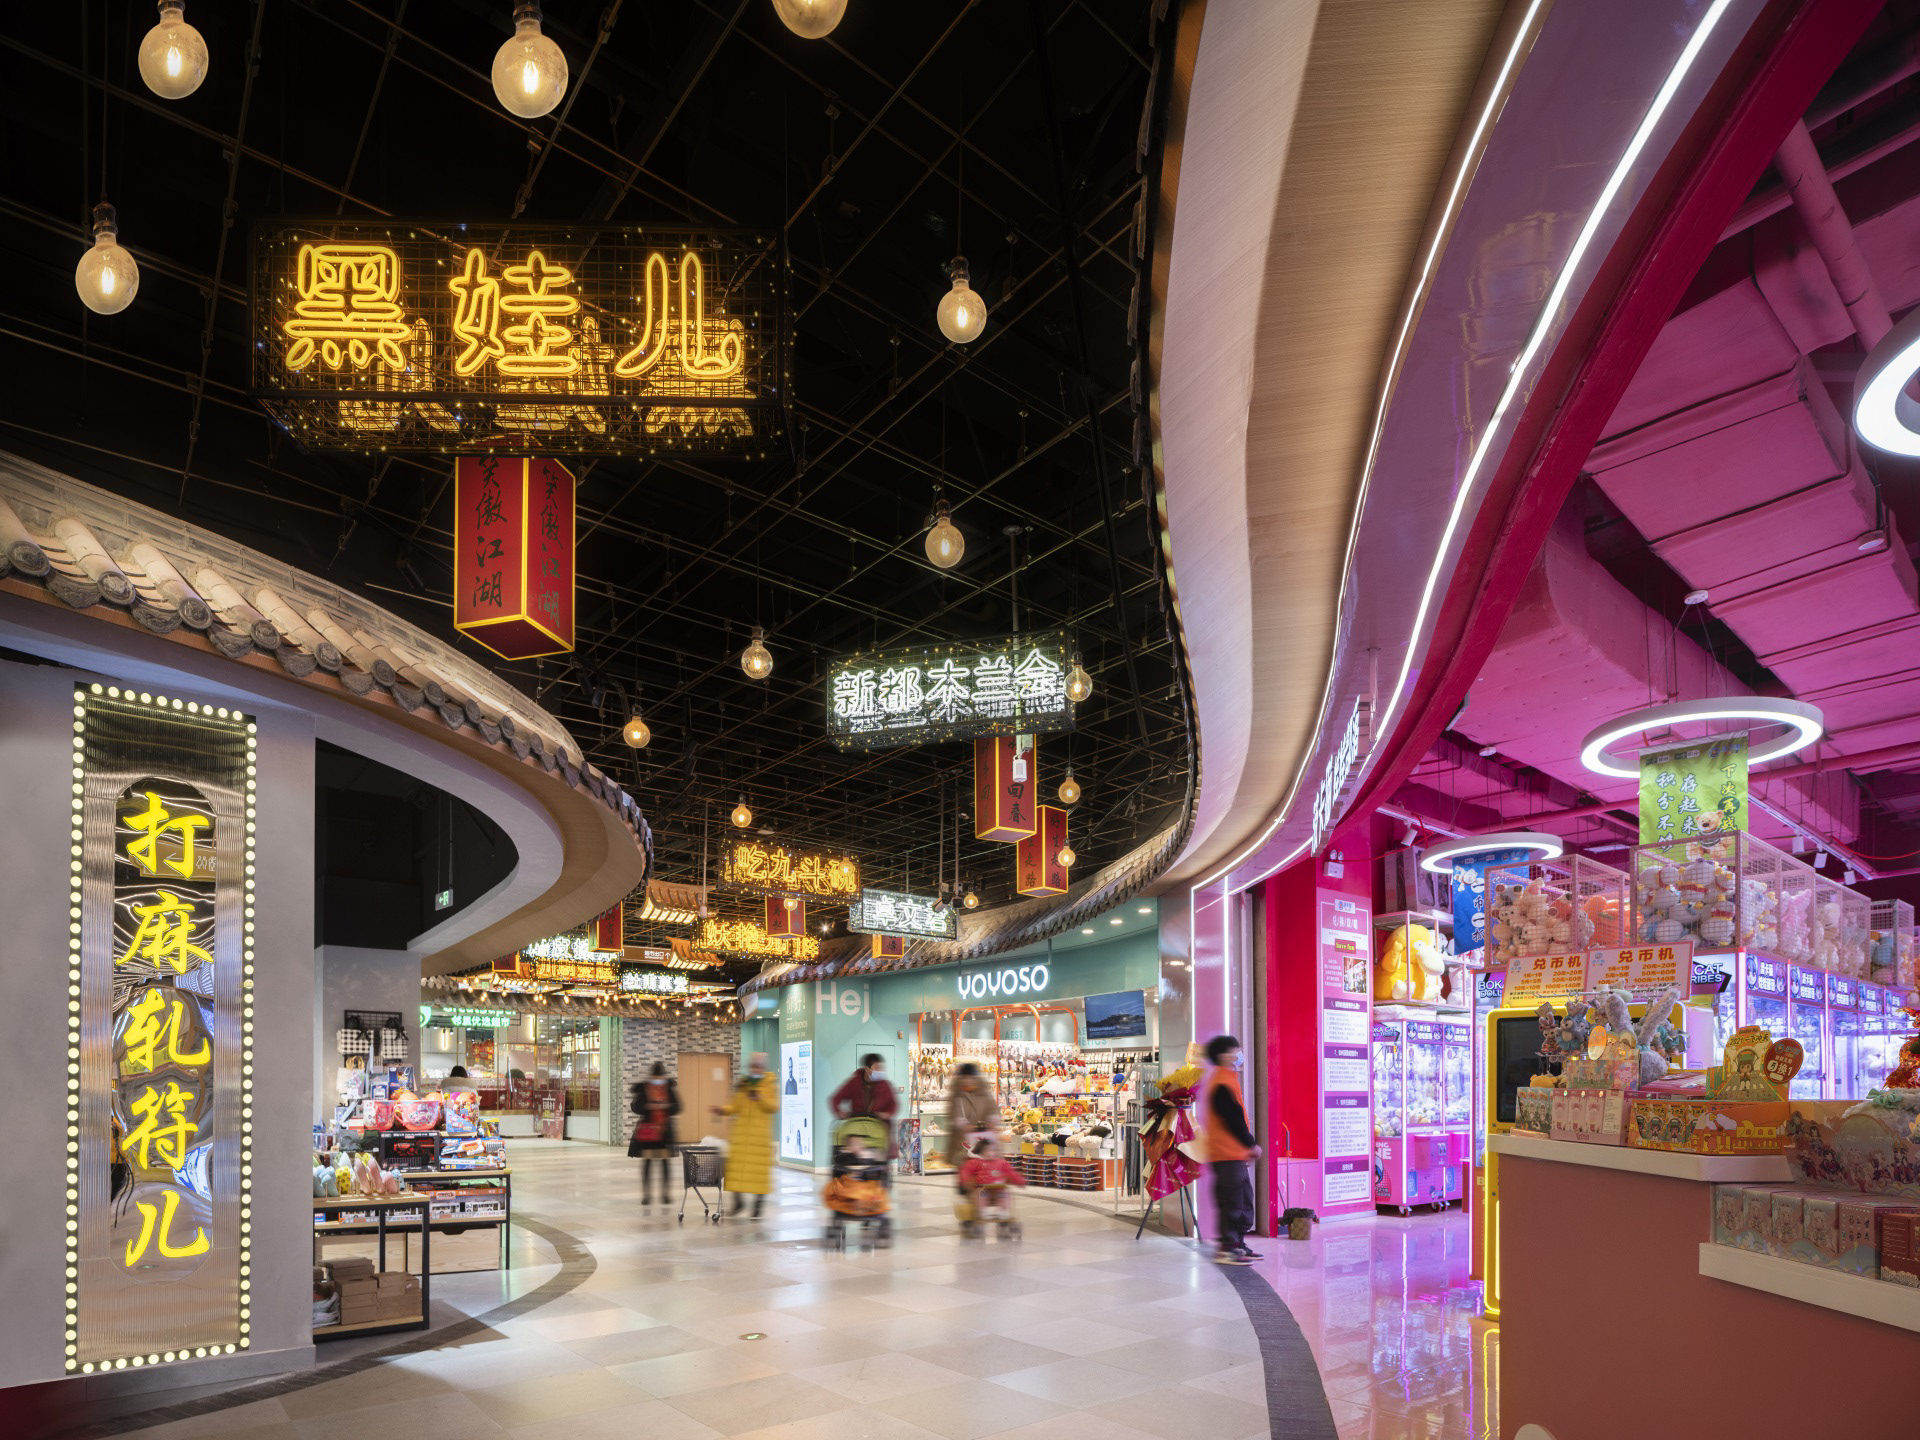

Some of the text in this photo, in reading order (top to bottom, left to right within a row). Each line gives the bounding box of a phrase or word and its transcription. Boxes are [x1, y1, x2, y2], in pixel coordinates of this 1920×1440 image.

[284, 243, 745, 380] 黑娃儿
[472, 457, 508, 609] 笑傲江湖
[537, 466, 563, 630] 笑傲江湖
[1678, 773, 1701, 835] 存起来
[1720, 763, 1738, 831] 下次再战
[1024, 837, 1037, 888] 生走路
[1532, 955, 1582, 971] 兑币机
[1618, 947, 1674, 963] 兑币机
[1694, 963, 1723, 975] CAT
[816, 981, 870, 1024] Hej
[958, 964, 1049, 999] YOYOSO
[1691, 974, 1722, 984] RIBES
